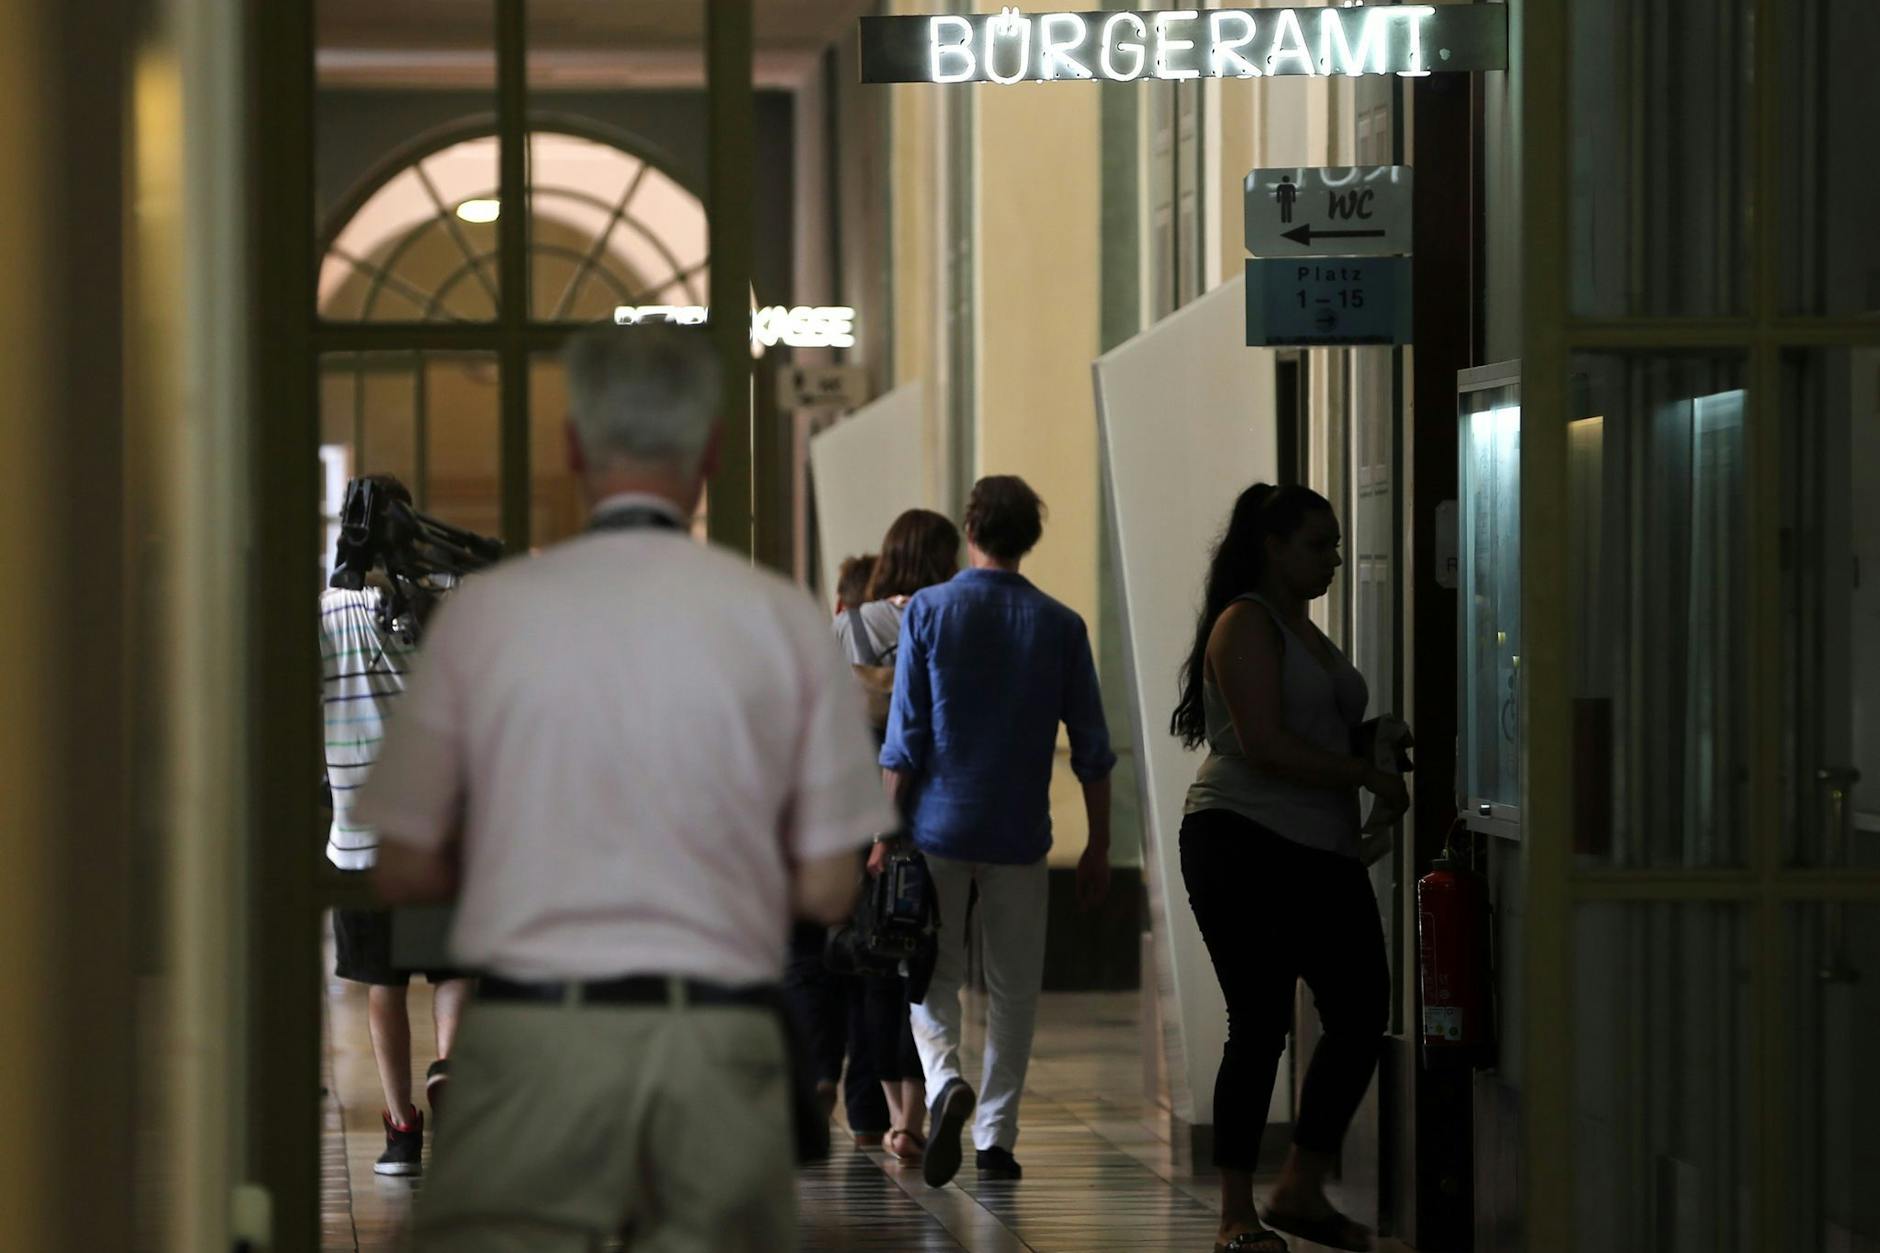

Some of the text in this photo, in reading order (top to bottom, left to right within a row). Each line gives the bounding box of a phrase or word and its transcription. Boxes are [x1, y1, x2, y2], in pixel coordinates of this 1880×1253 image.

[929, 4, 1436, 84] BÜRGERAMT
[1327, 188, 1375, 220] WC
[1297, 266, 1362, 281] Platz
[1296, 289, 1307, 308] 1
[1337, 289, 1364, 309] 15
